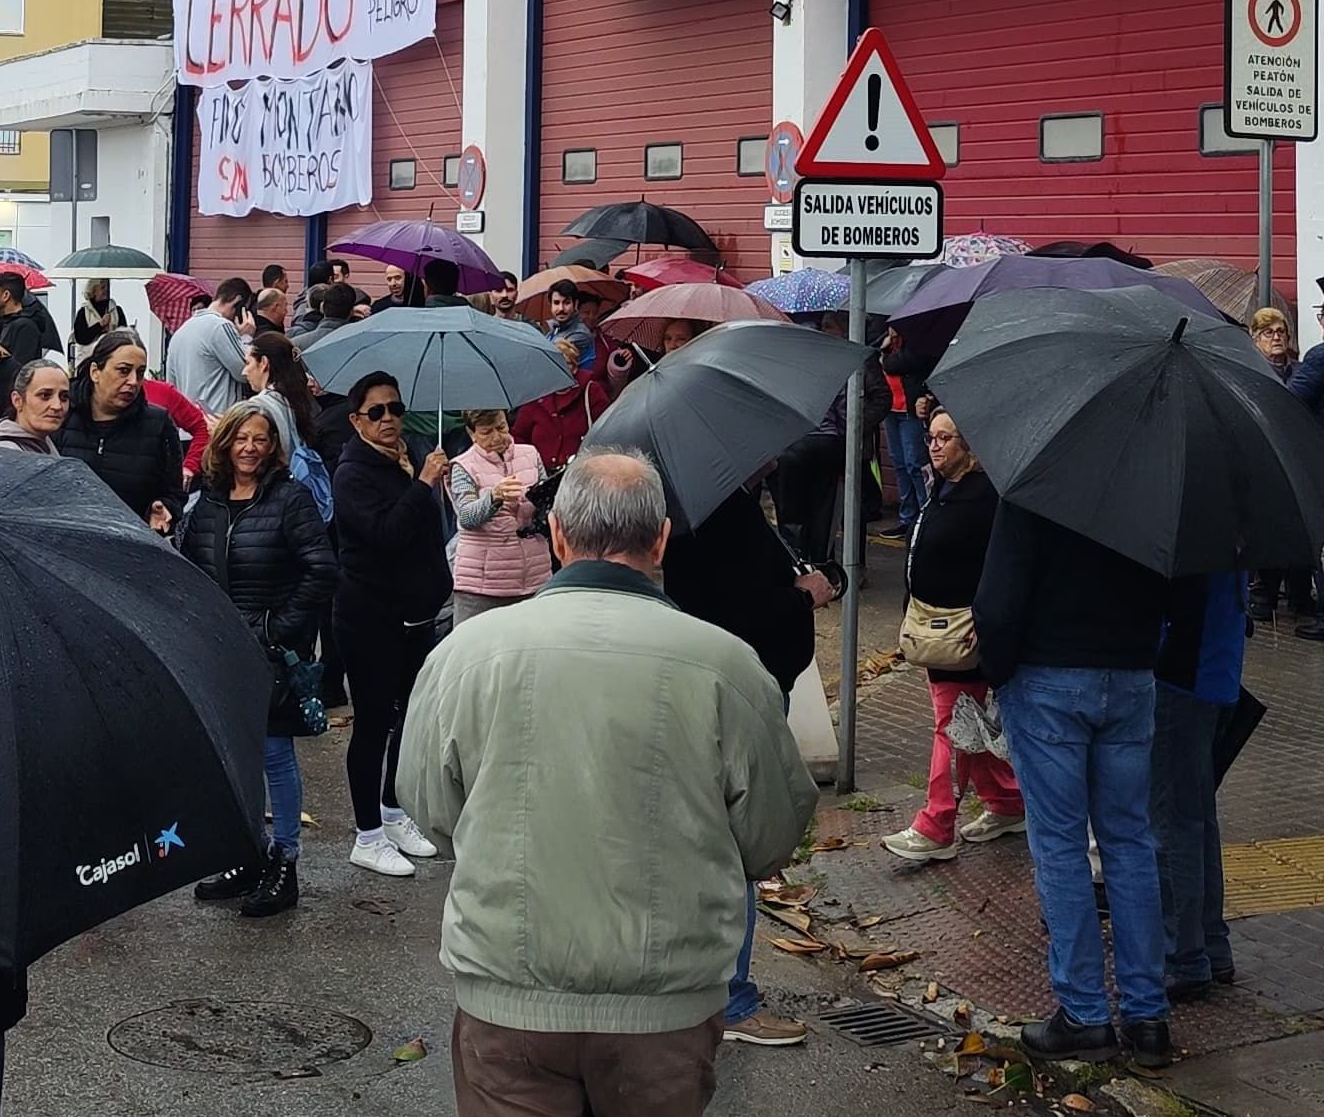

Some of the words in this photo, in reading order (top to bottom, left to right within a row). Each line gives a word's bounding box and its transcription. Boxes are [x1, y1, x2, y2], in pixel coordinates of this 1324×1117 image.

[1247, 54, 1301, 68] ATENCIÓN
[1253, 69, 1295, 83] PEATÓN
[1246, 85, 1283, 98] SALIDA
[1288, 88, 1302, 99] DE
[1235, 98, 1294, 114] VEHÍCULOS
[1298, 105, 1312, 115] DE
[1244, 116, 1303, 129] BOMBEROS
[261, 149, 342, 197] BOMBEROS
[803, 194, 854, 215] SALIDA
[857, 190, 933, 215] VEHÍCULOS
[821, 225, 840, 245] DE
[843, 226, 920, 246] BOMBEROS
[76, 842, 141, 886] Cajasol
